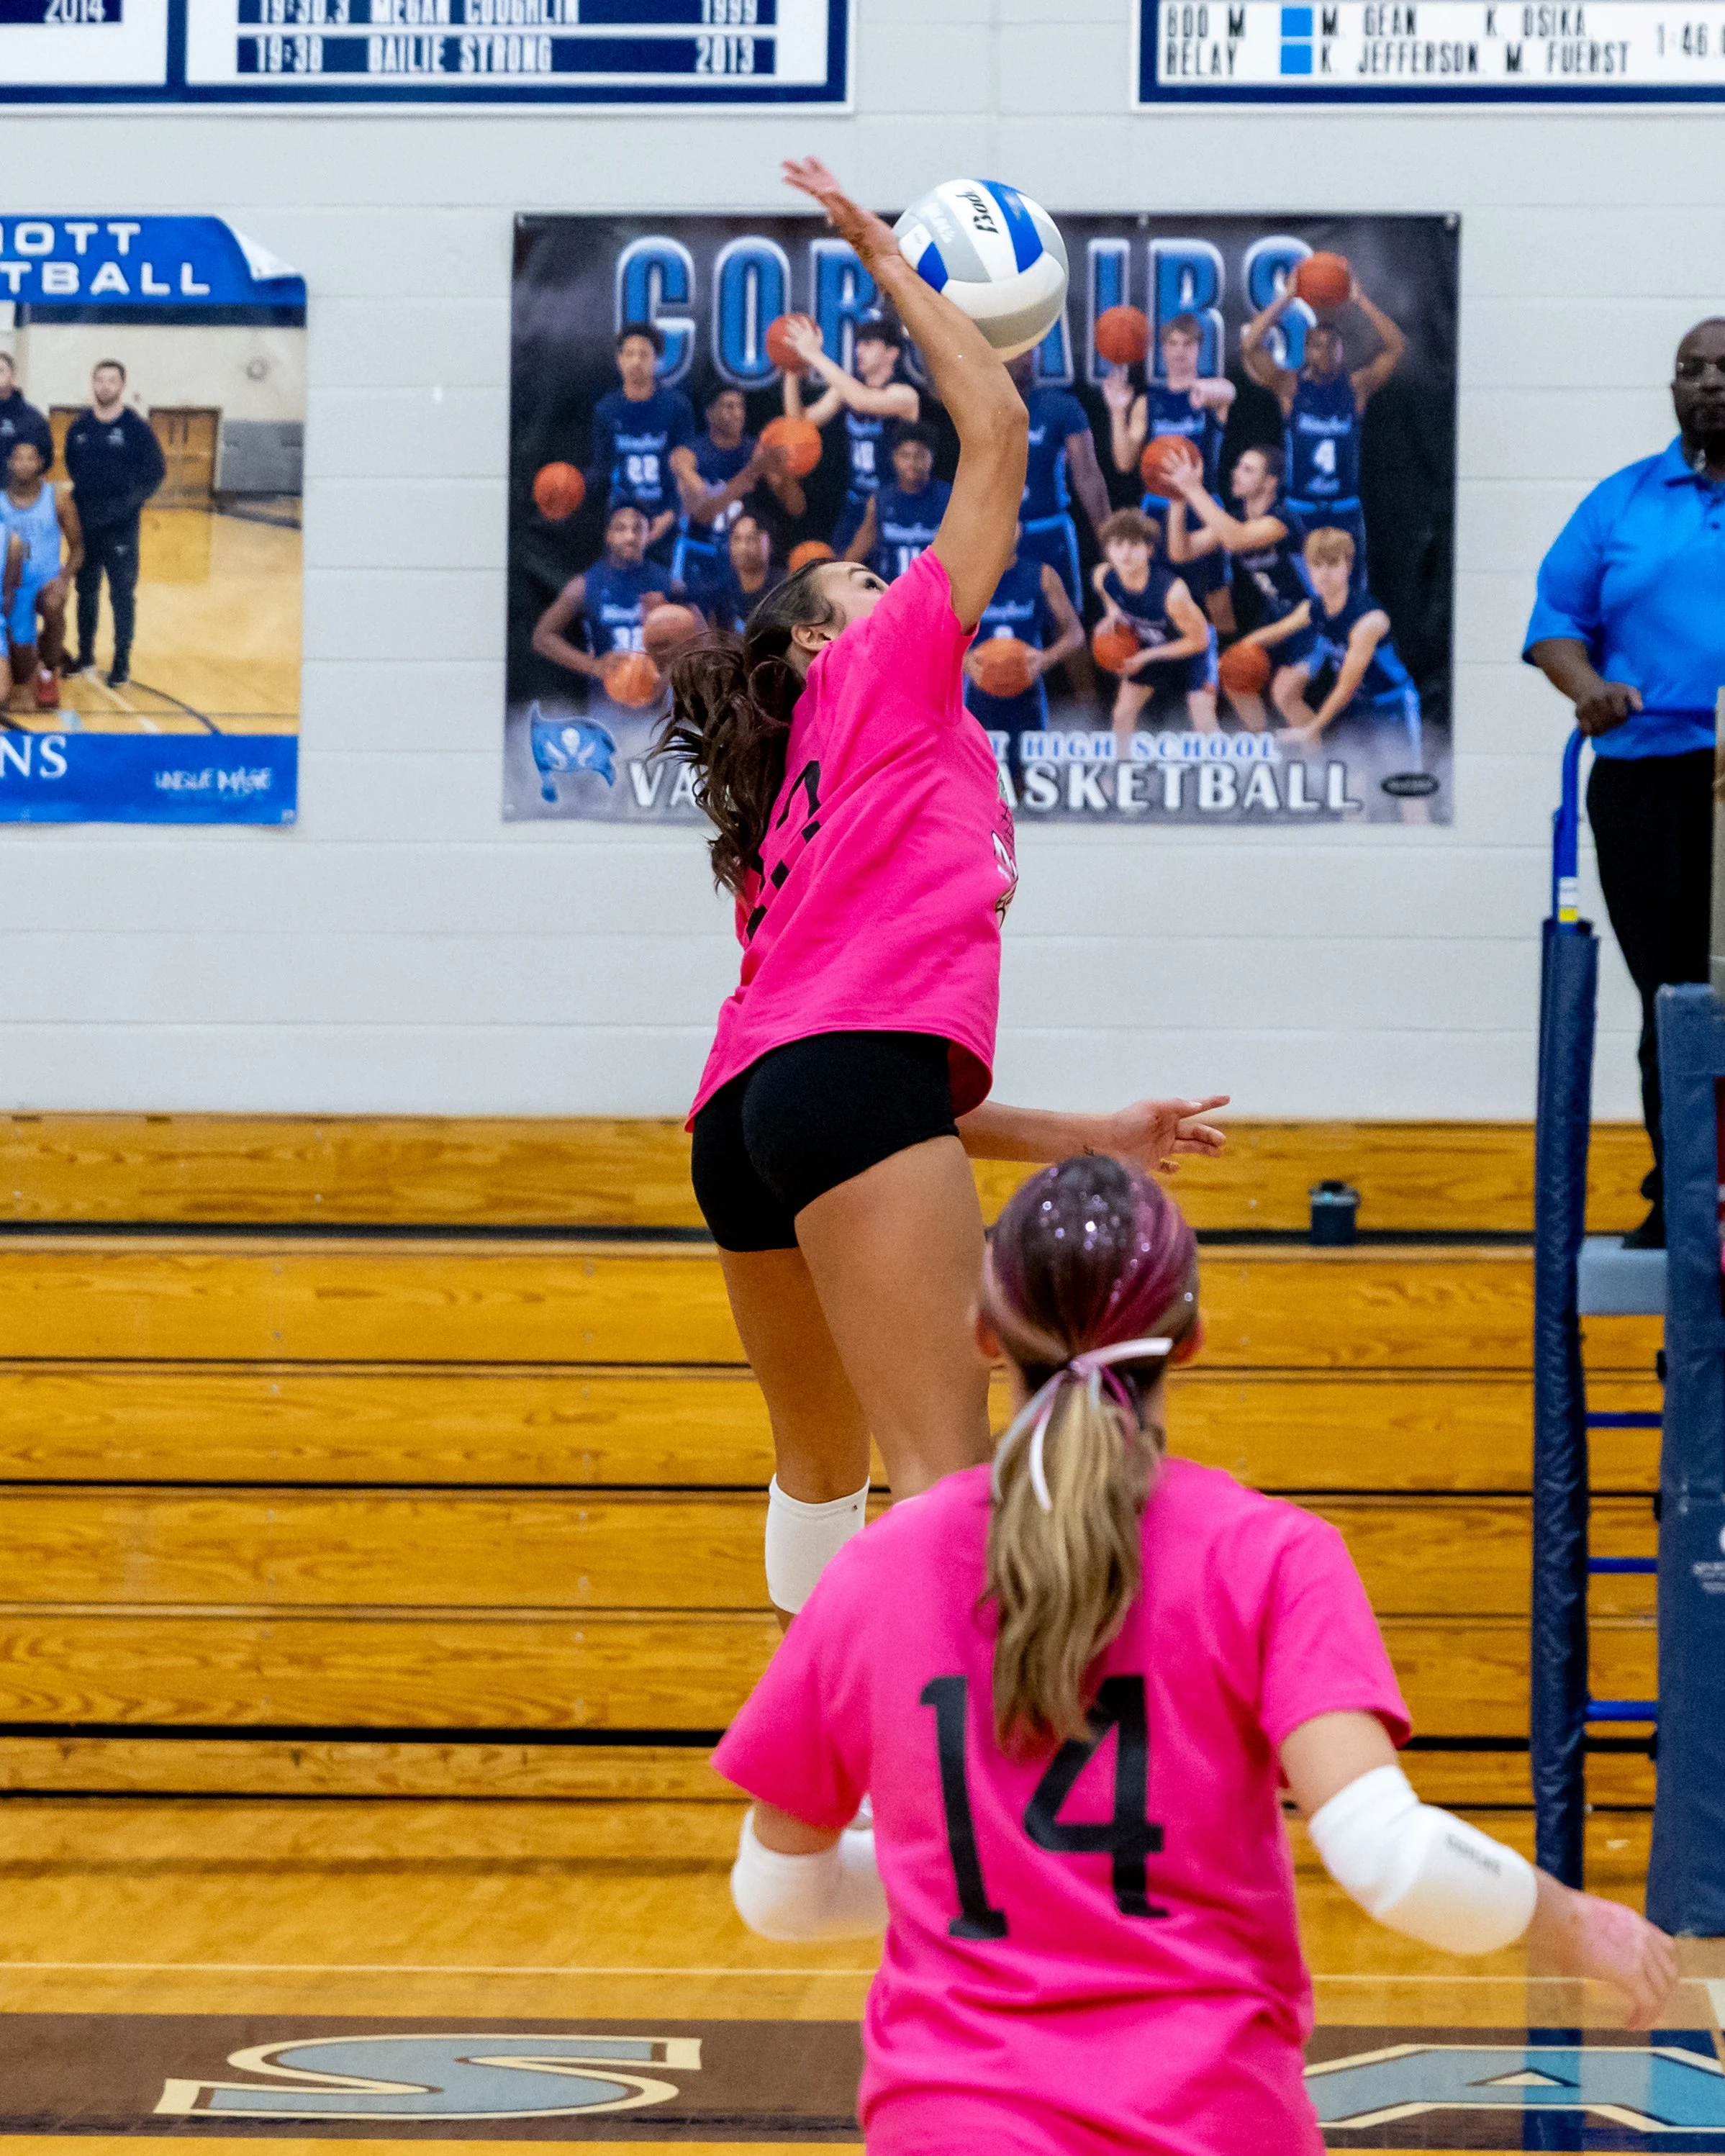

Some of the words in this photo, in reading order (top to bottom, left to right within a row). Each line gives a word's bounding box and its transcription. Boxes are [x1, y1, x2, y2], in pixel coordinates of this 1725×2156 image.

[368, 35, 445, 73] BAILIE
[460, 35, 553, 73] STRONG
[696, 35, 755, 73] 2013
[1166, 41, 1238, 75] RELAY
[1548, 41, 1630, 74] FUERST
[615, 235, 1318, 387] CORIRS
[1023, 732, 1115, 761] HIGH
[1131, 732, 1282, 763] SCHOOL
[997, 762, 1361, 810] ASKETBALL
[919, 1674, 1170, 1941] 14
